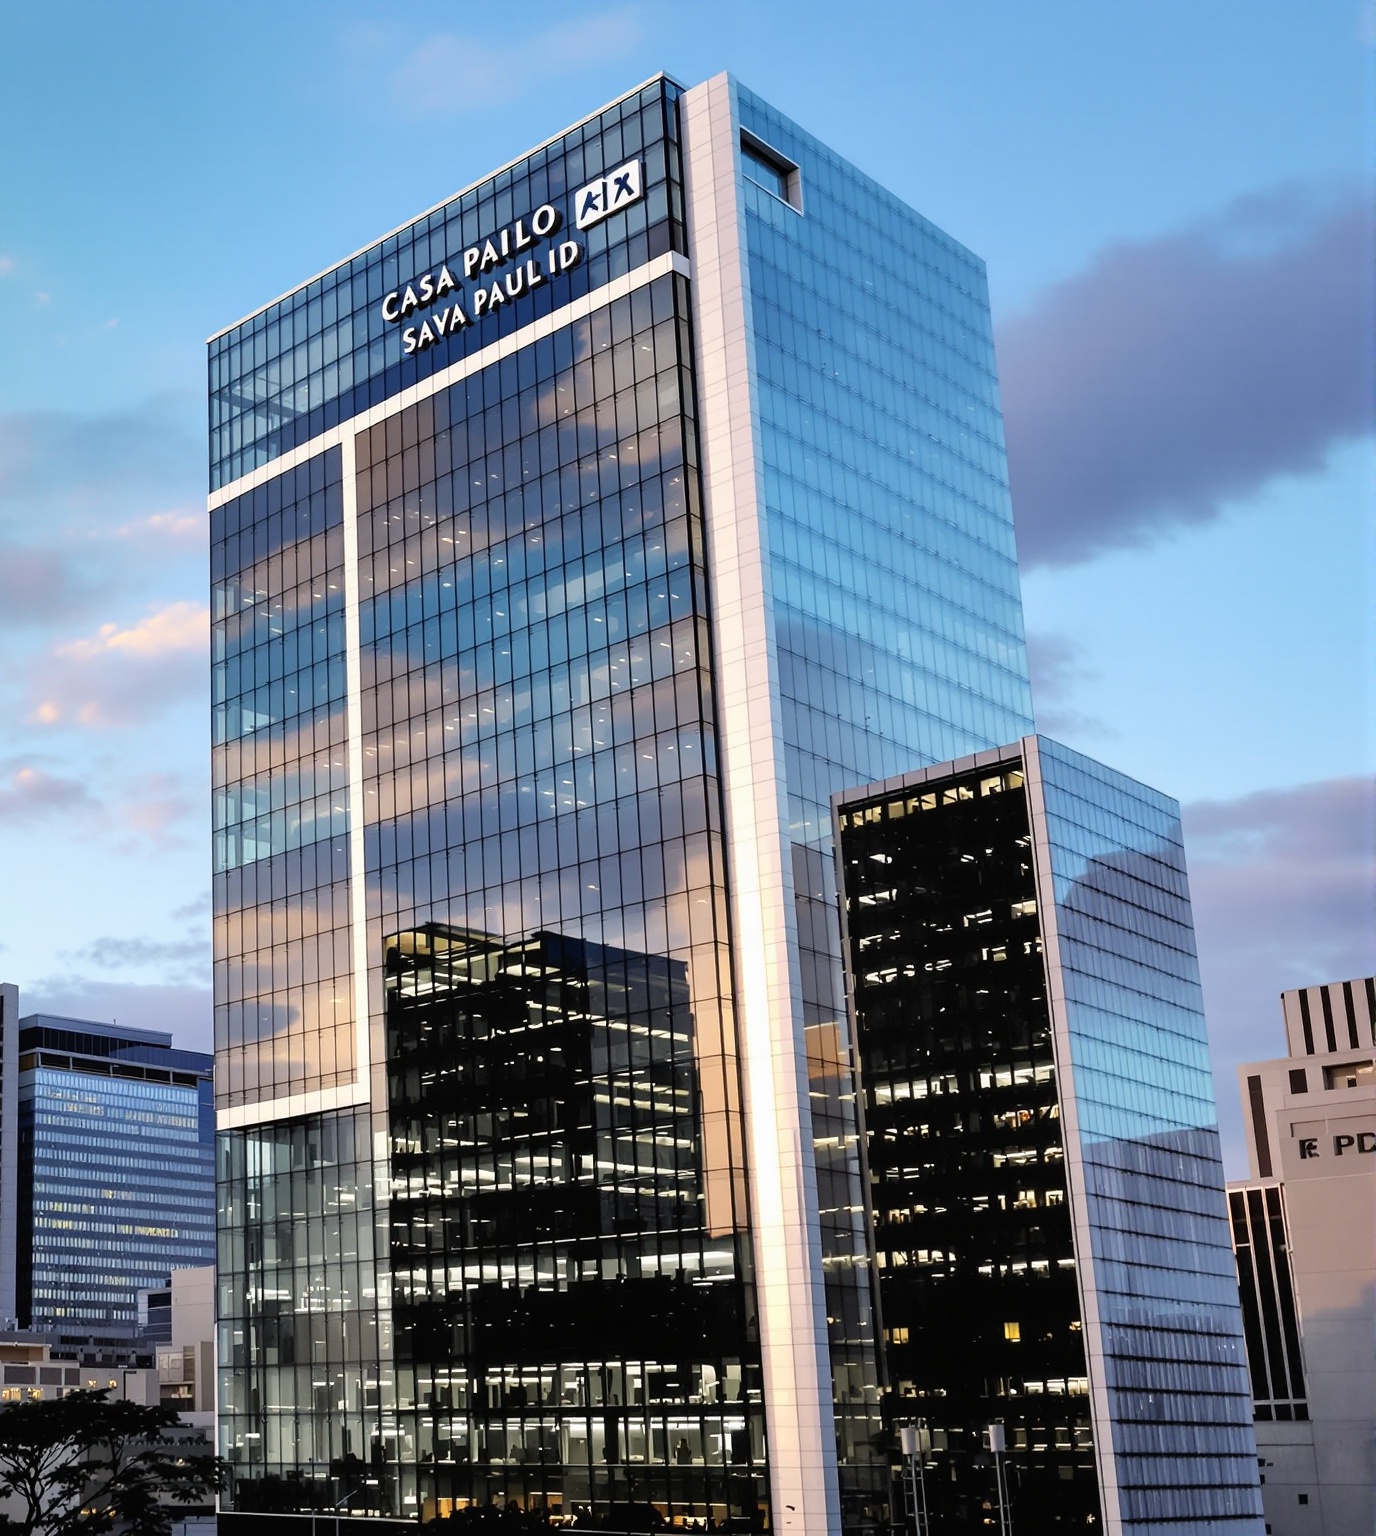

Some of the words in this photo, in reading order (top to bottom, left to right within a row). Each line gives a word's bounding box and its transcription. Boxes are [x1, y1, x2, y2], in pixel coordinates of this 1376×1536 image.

[381, 264, 455, 321] CASA
[463, 204, 557, 277] PAILO
[402, 303, 466, 354] SAVA
[474, 259, 542, 316] PAUL
[548, 241, 579, 274] ID
